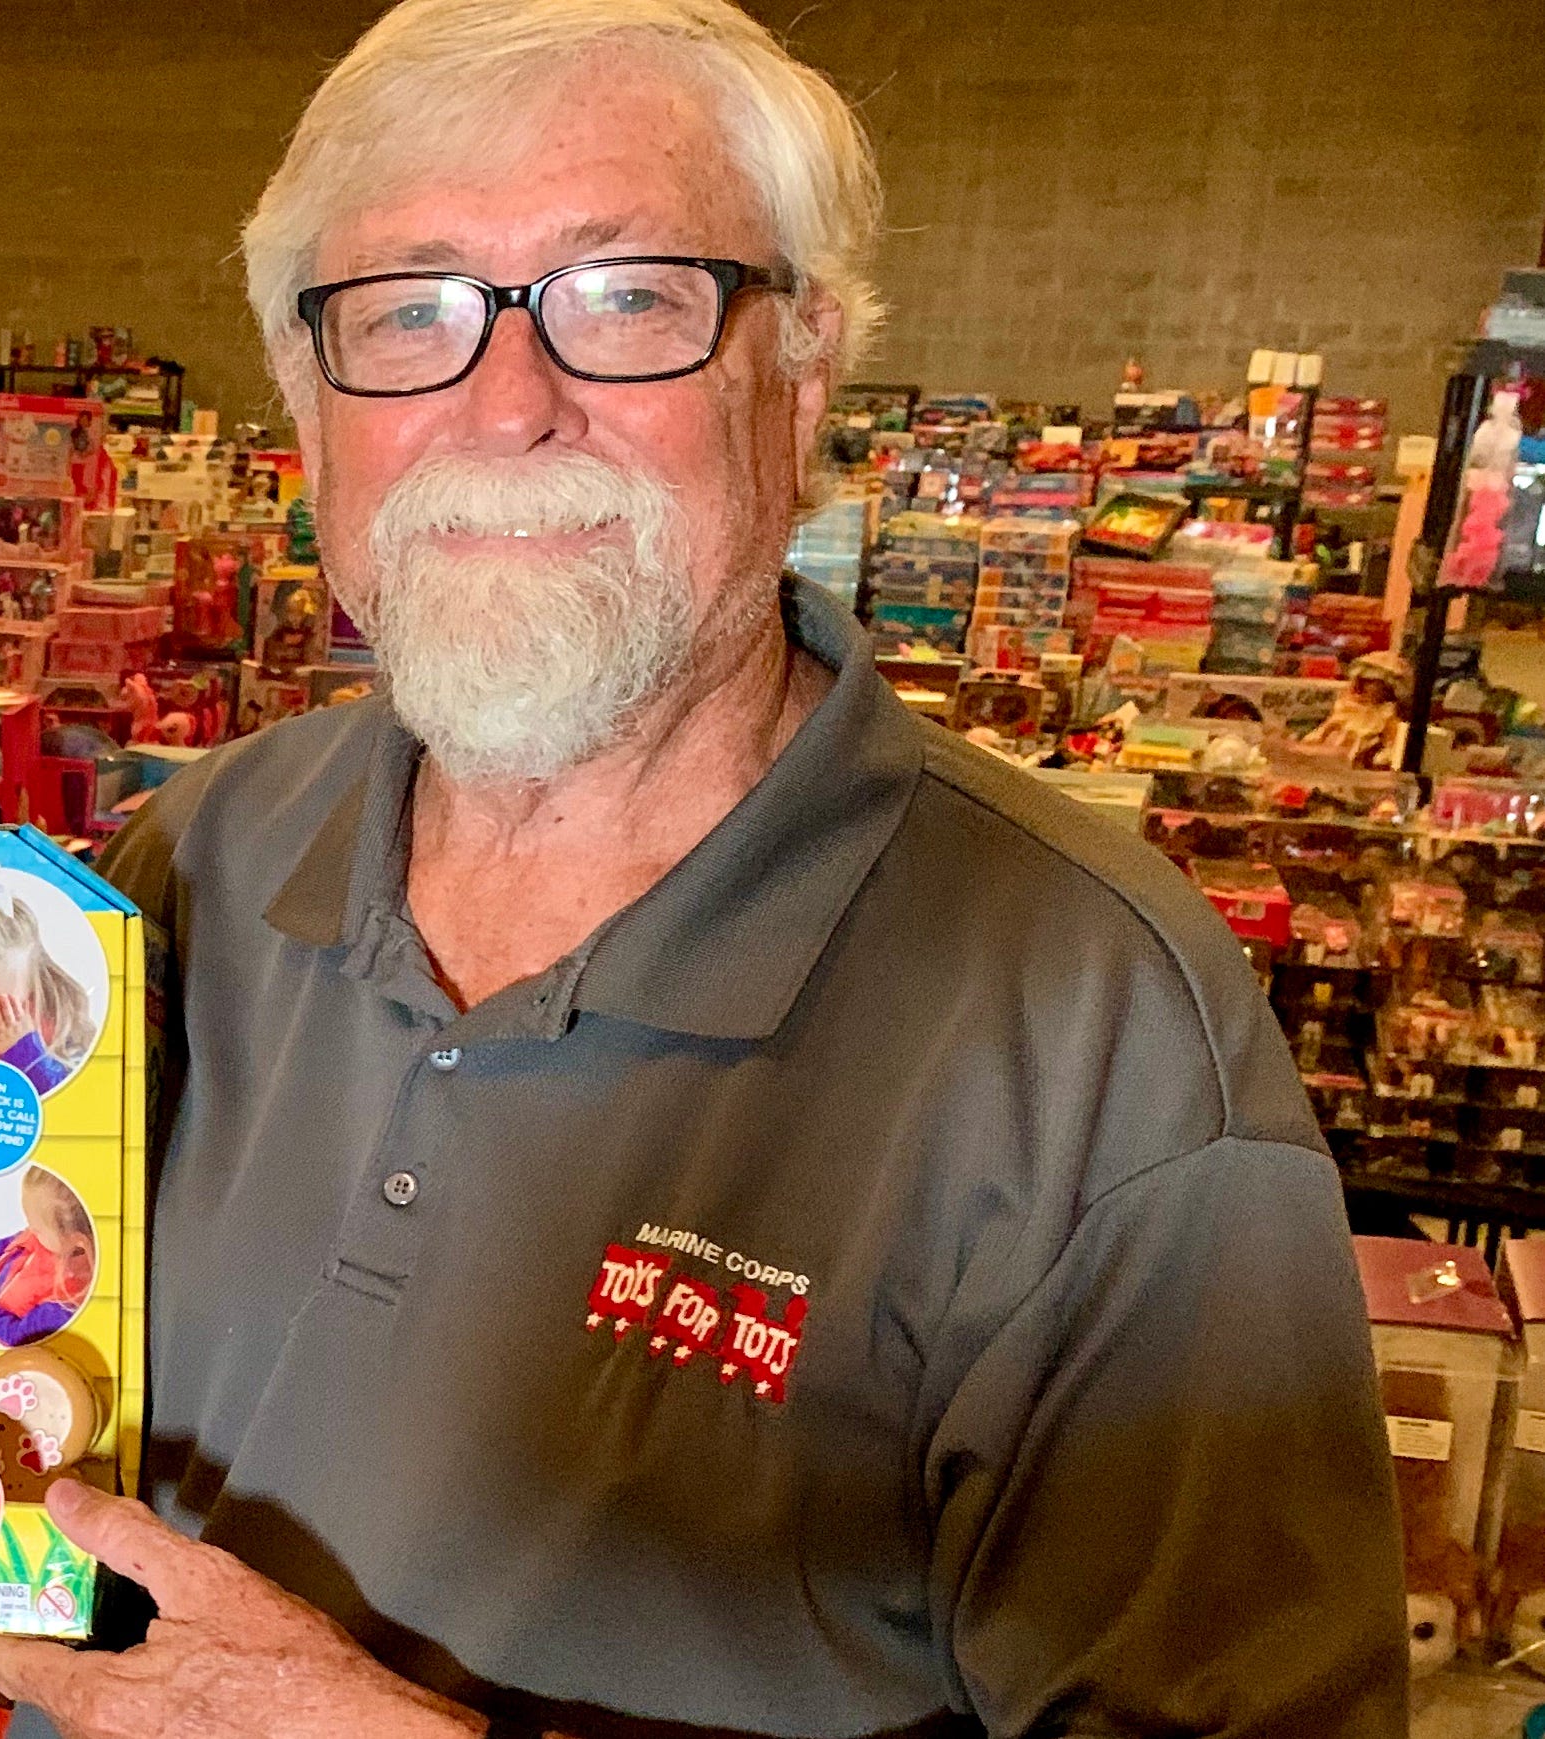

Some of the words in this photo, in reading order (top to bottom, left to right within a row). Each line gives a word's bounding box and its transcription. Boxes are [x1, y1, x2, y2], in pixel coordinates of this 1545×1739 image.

[13, 1098, 24, 1108] IS
[7, 1110, 36, 1123] CALL
[15, 1124, 34, 1135] HIS
[635, 1222, 723, 1265] MARINE
[725, 1252, 810, 1295] CORPS
[602, 1260, 663, 1307] TOYS
[663, 1282, 720, 1342] FOR
[733, 1312, 797, 1375] TOTS
